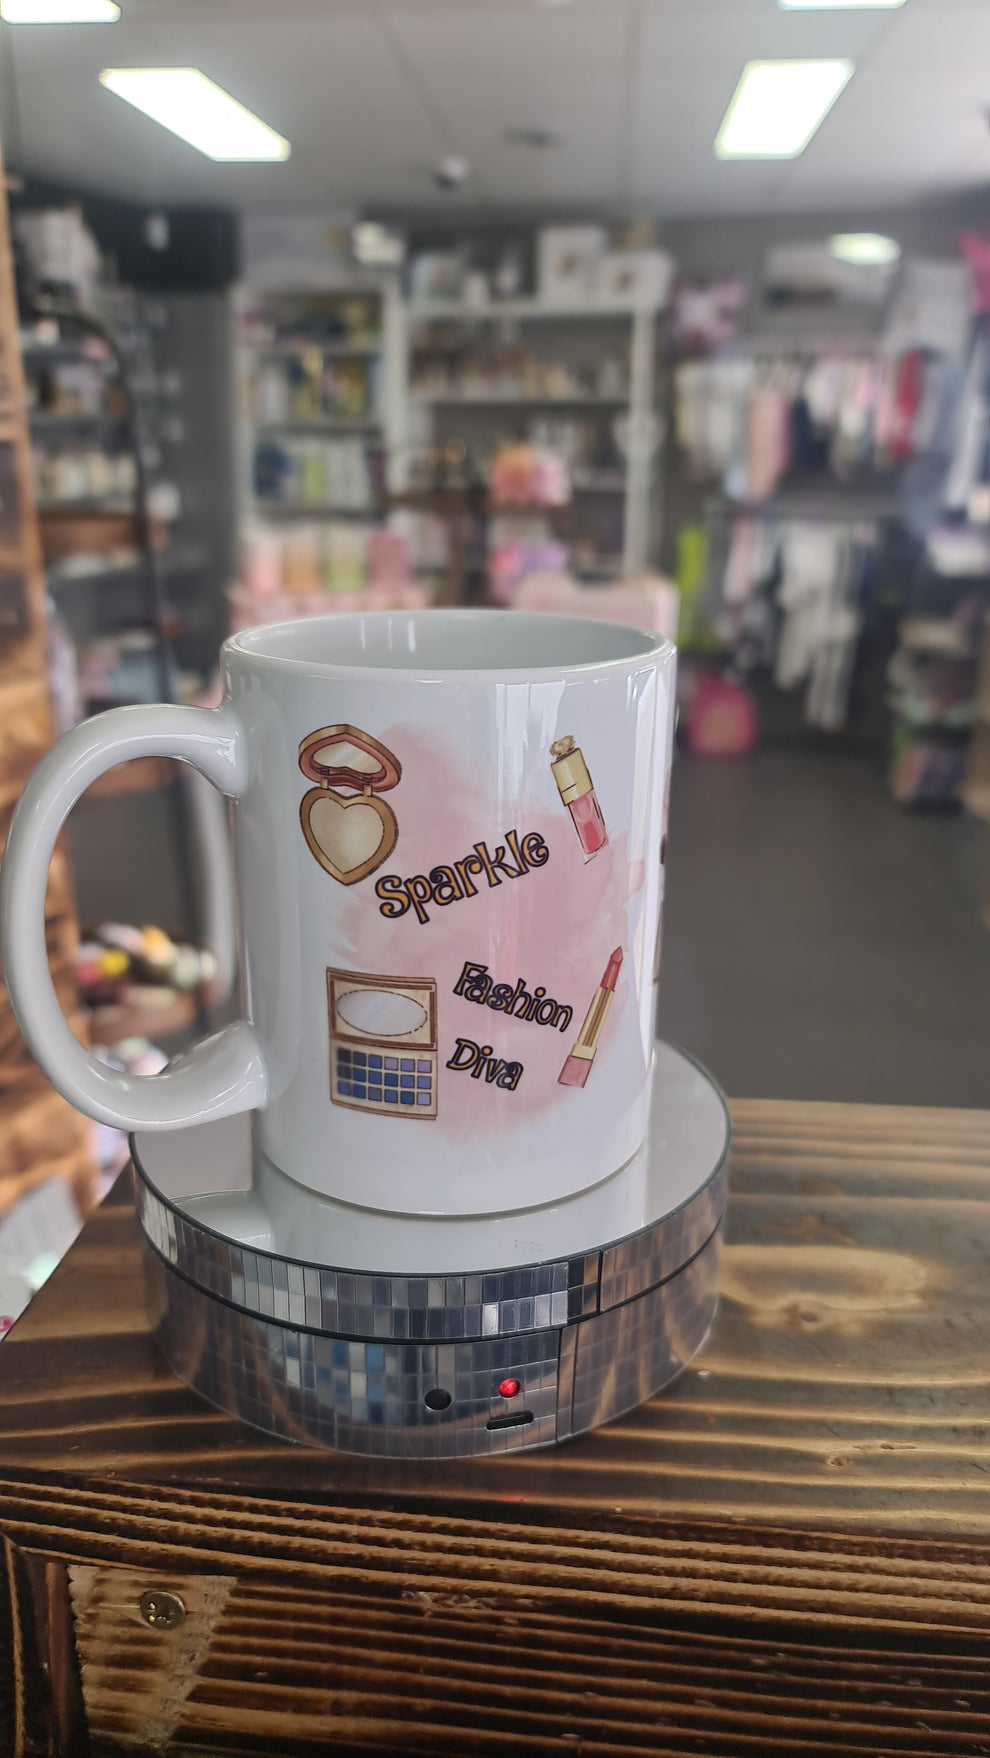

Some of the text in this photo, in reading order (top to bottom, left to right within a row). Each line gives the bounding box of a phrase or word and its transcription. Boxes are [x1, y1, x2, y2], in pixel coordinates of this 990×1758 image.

[375, 829, 549, 924] Sparkle
[453, 961, 573, 1032] Fashion
[446, 1038, 524, 1091] Diva
